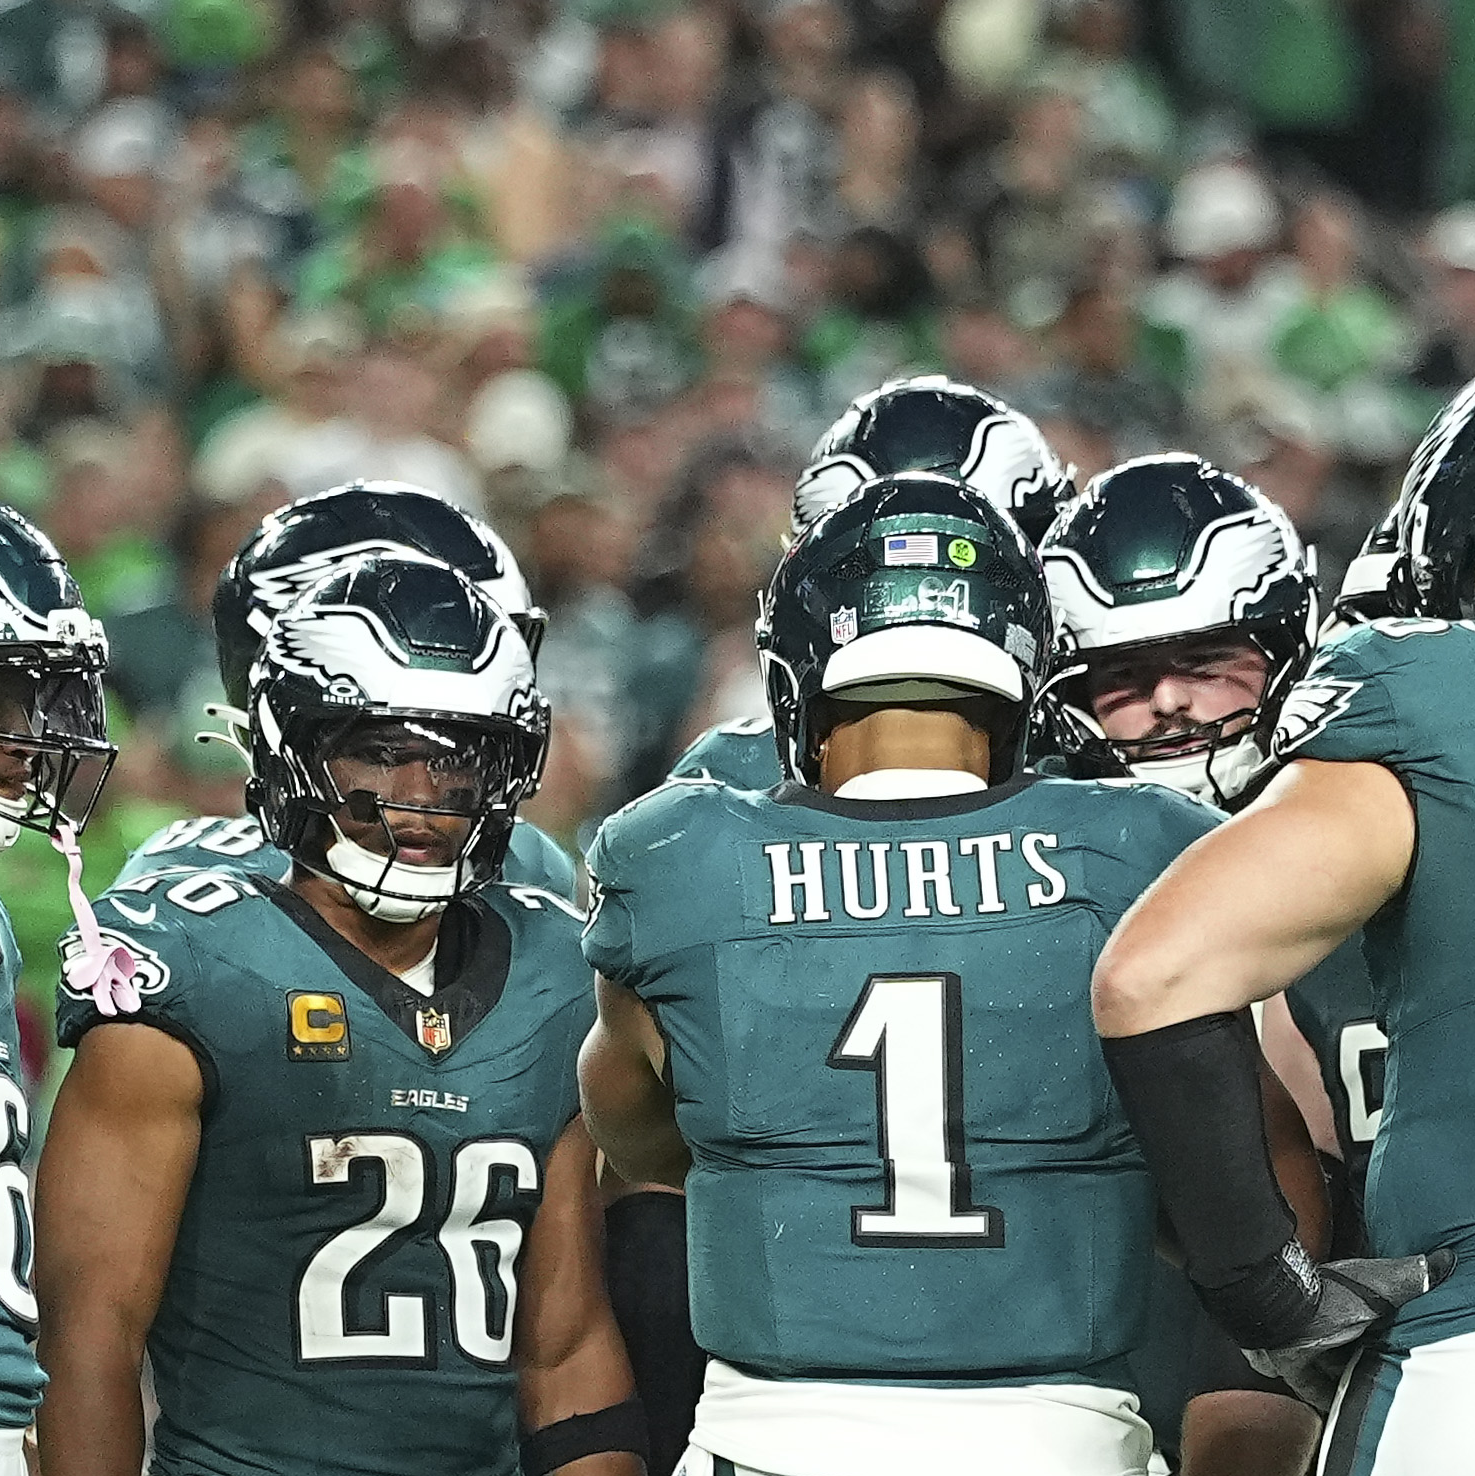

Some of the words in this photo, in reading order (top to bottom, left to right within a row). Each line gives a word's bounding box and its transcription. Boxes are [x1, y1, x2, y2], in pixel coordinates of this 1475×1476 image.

[764, 832, 1068, 925] HURTS
[290, 994, 345, 1044] C
[390, 1089, 470, 1113] EAGLES
[826, 971, 1005, 1248] 1
[296, 1129, 544, 1370] 26
